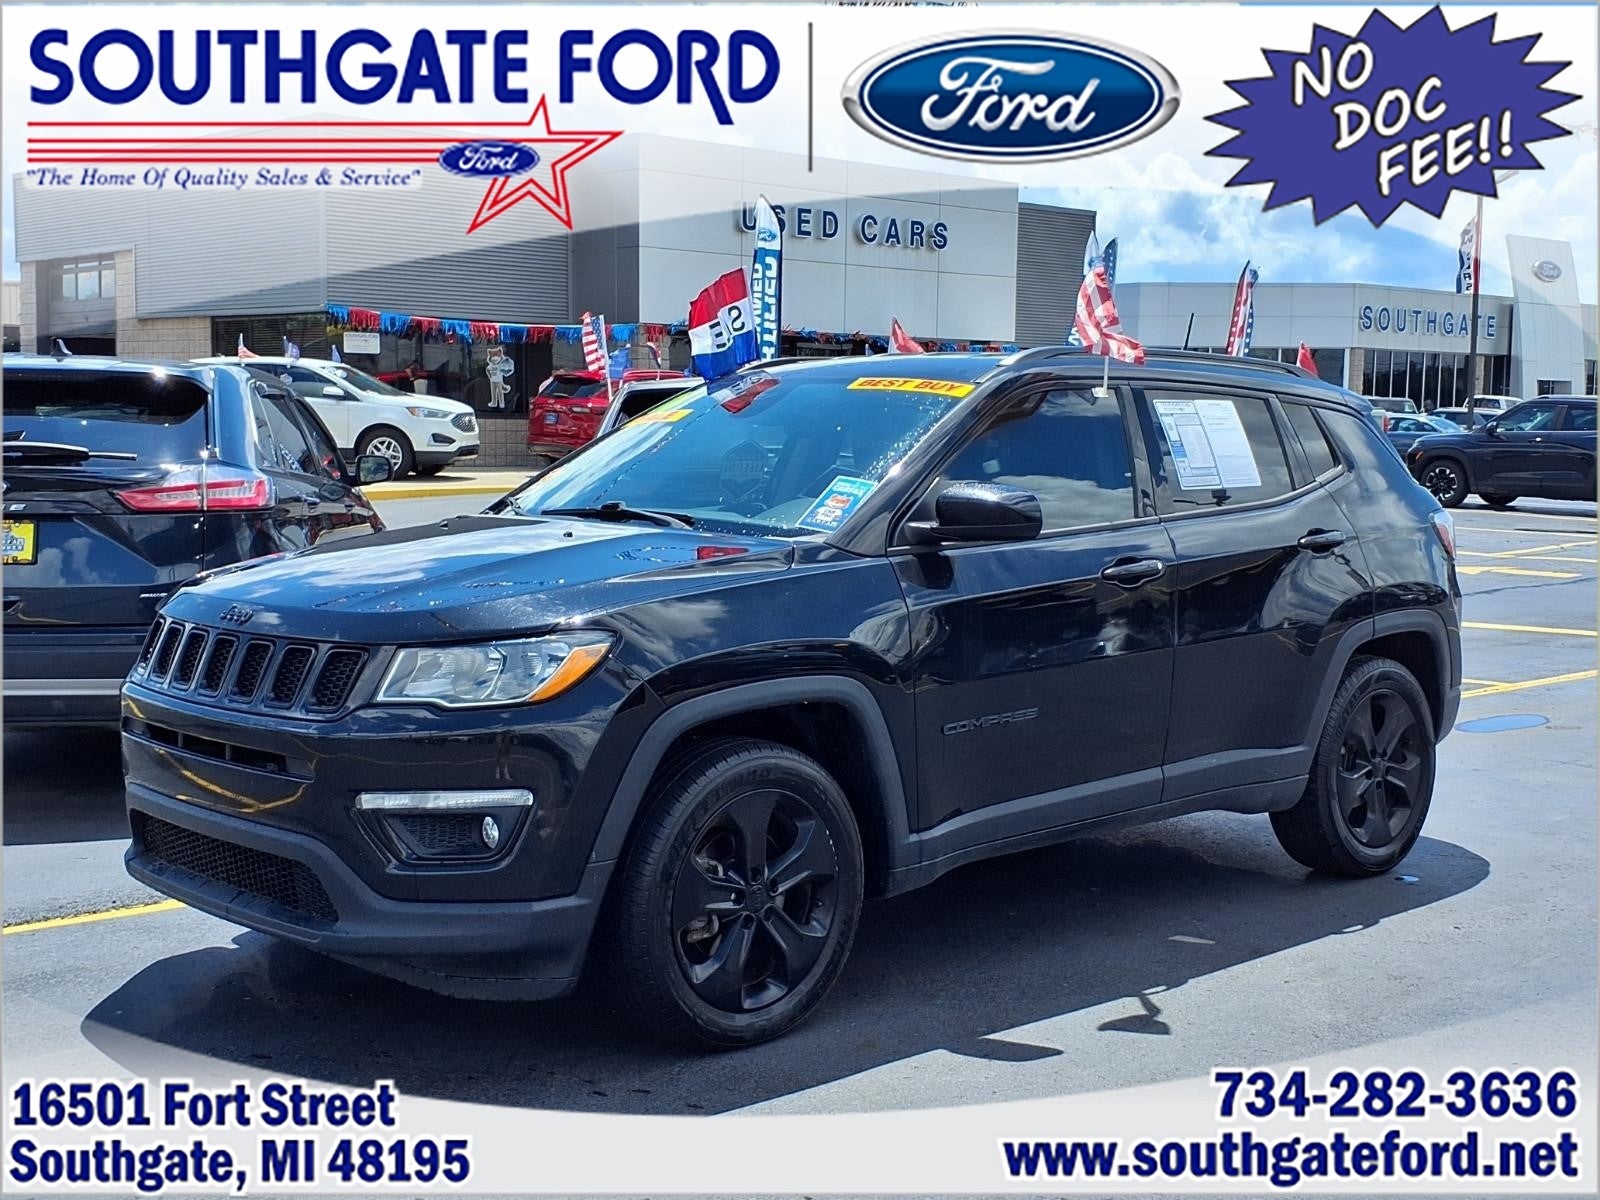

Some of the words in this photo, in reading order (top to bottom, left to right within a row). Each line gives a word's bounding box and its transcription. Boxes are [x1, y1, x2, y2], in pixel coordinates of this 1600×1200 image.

[741, 202, 839, 239] USED
[860, 213, 949, 250] CARS
[858, 379, 912, 388] BEST
[912, 381, 961, 392] BUY
